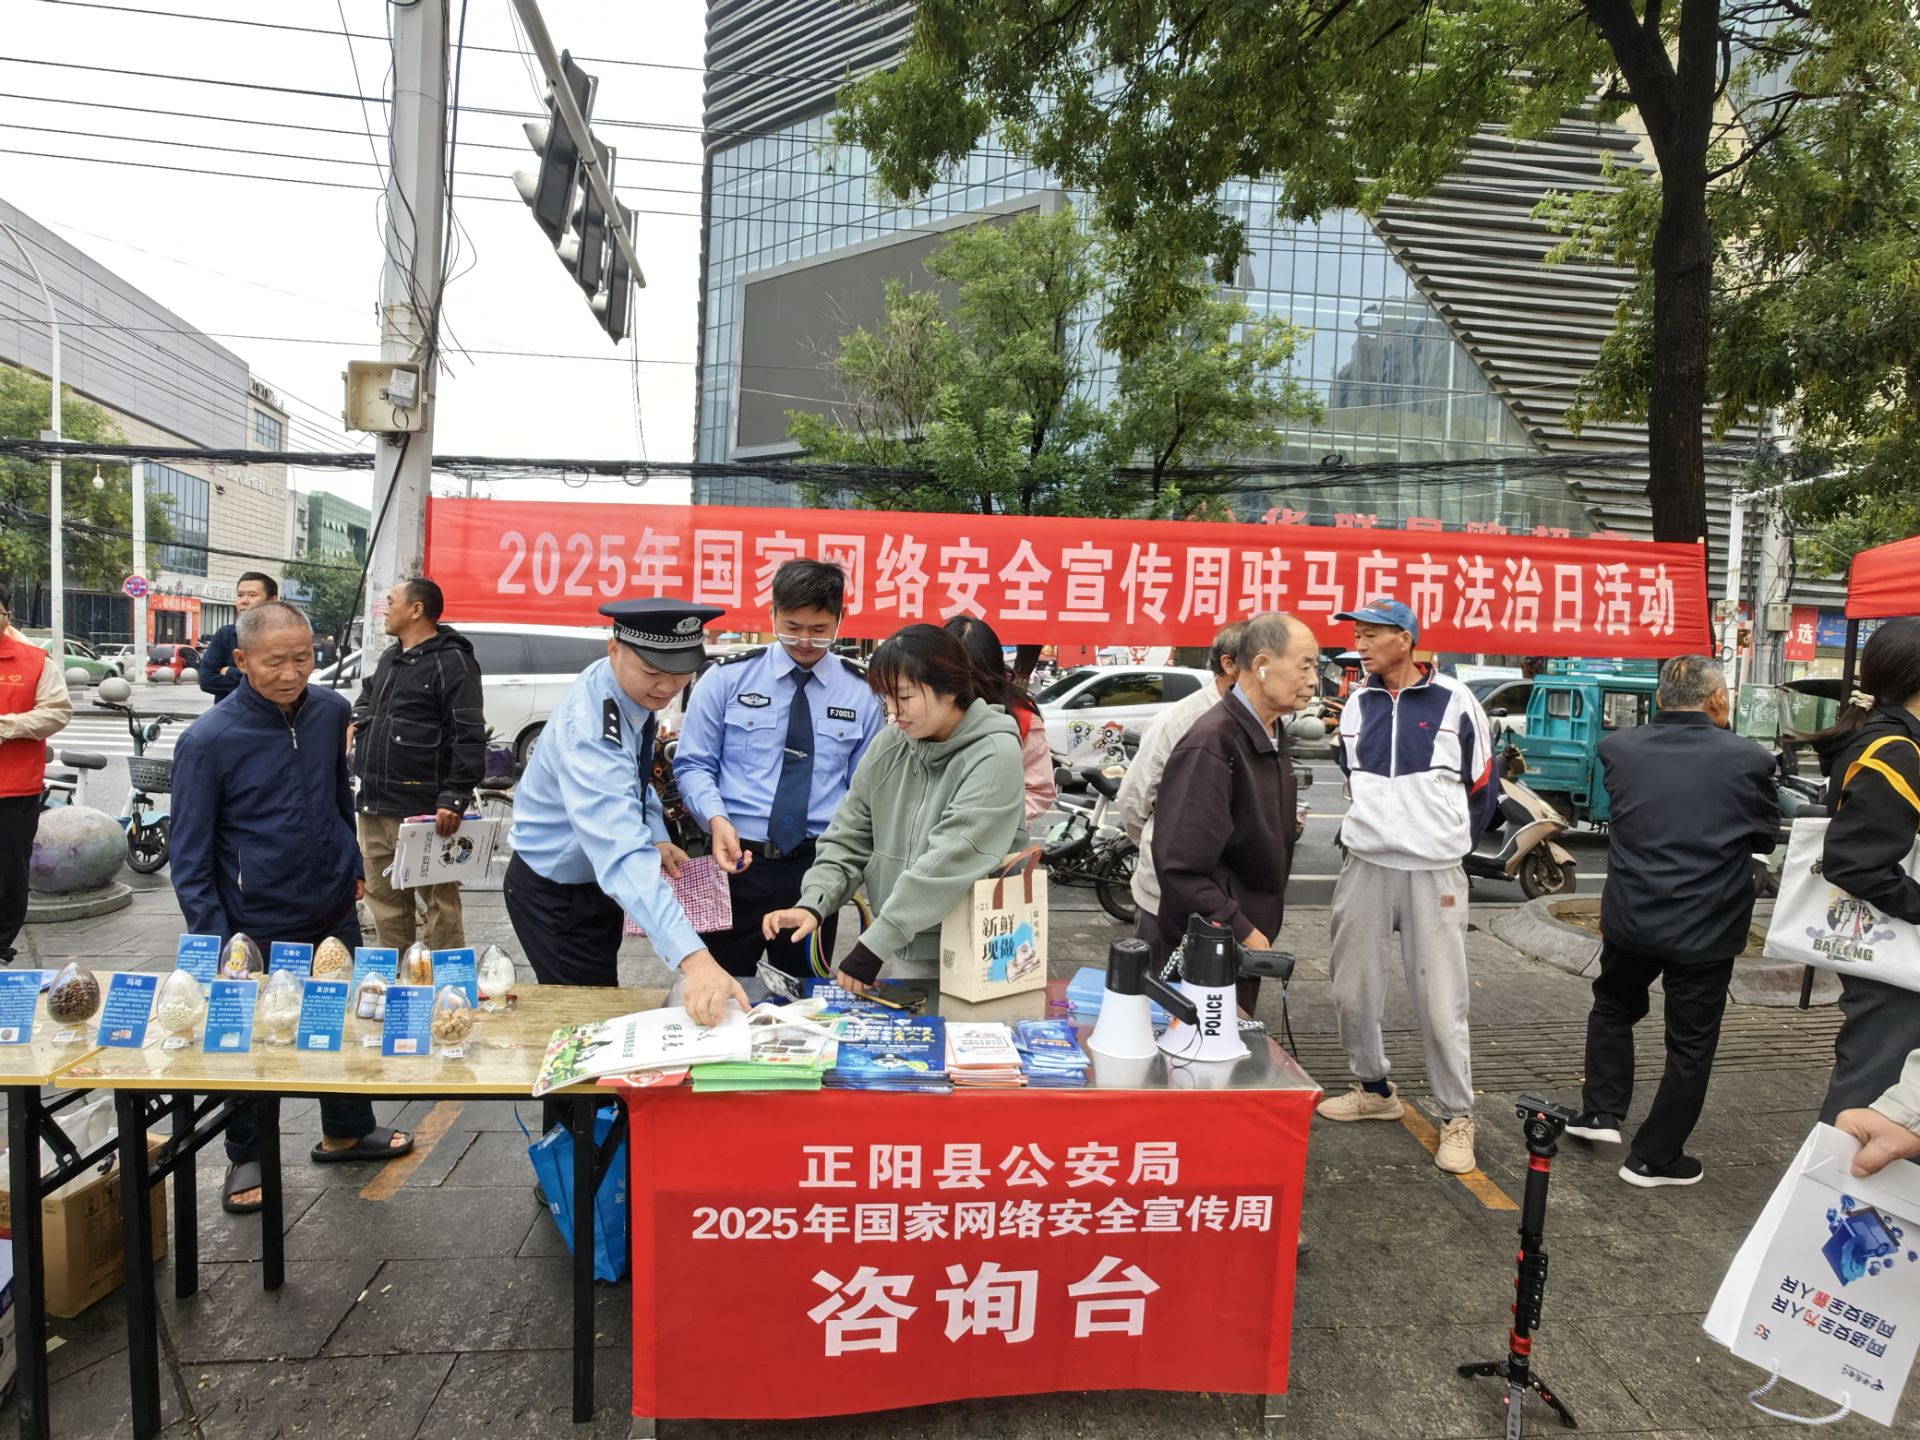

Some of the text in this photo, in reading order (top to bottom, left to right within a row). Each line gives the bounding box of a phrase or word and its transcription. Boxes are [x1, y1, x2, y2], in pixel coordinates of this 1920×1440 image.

[496, 526, 1676, 638] 2025年国家网络安全宣传周驻马店市法治日活动
[982, 913, 1015, 939] 新鲜
[982, 937, 1015, 961] 现做
[1204, 994, 1223, 1036] POLICE
[798, 1140, 1182, 1190] 正阳县公安局
[691, 1194, 1275, 1243] 2025年国家网络安全宣传周
[806, 1255, 1161, 1358] 咨询台
[1771, 1294, 1888, 1359] 网络安全为人民
[1780, 1275, 1897, 1340] 网络安全靠人民
